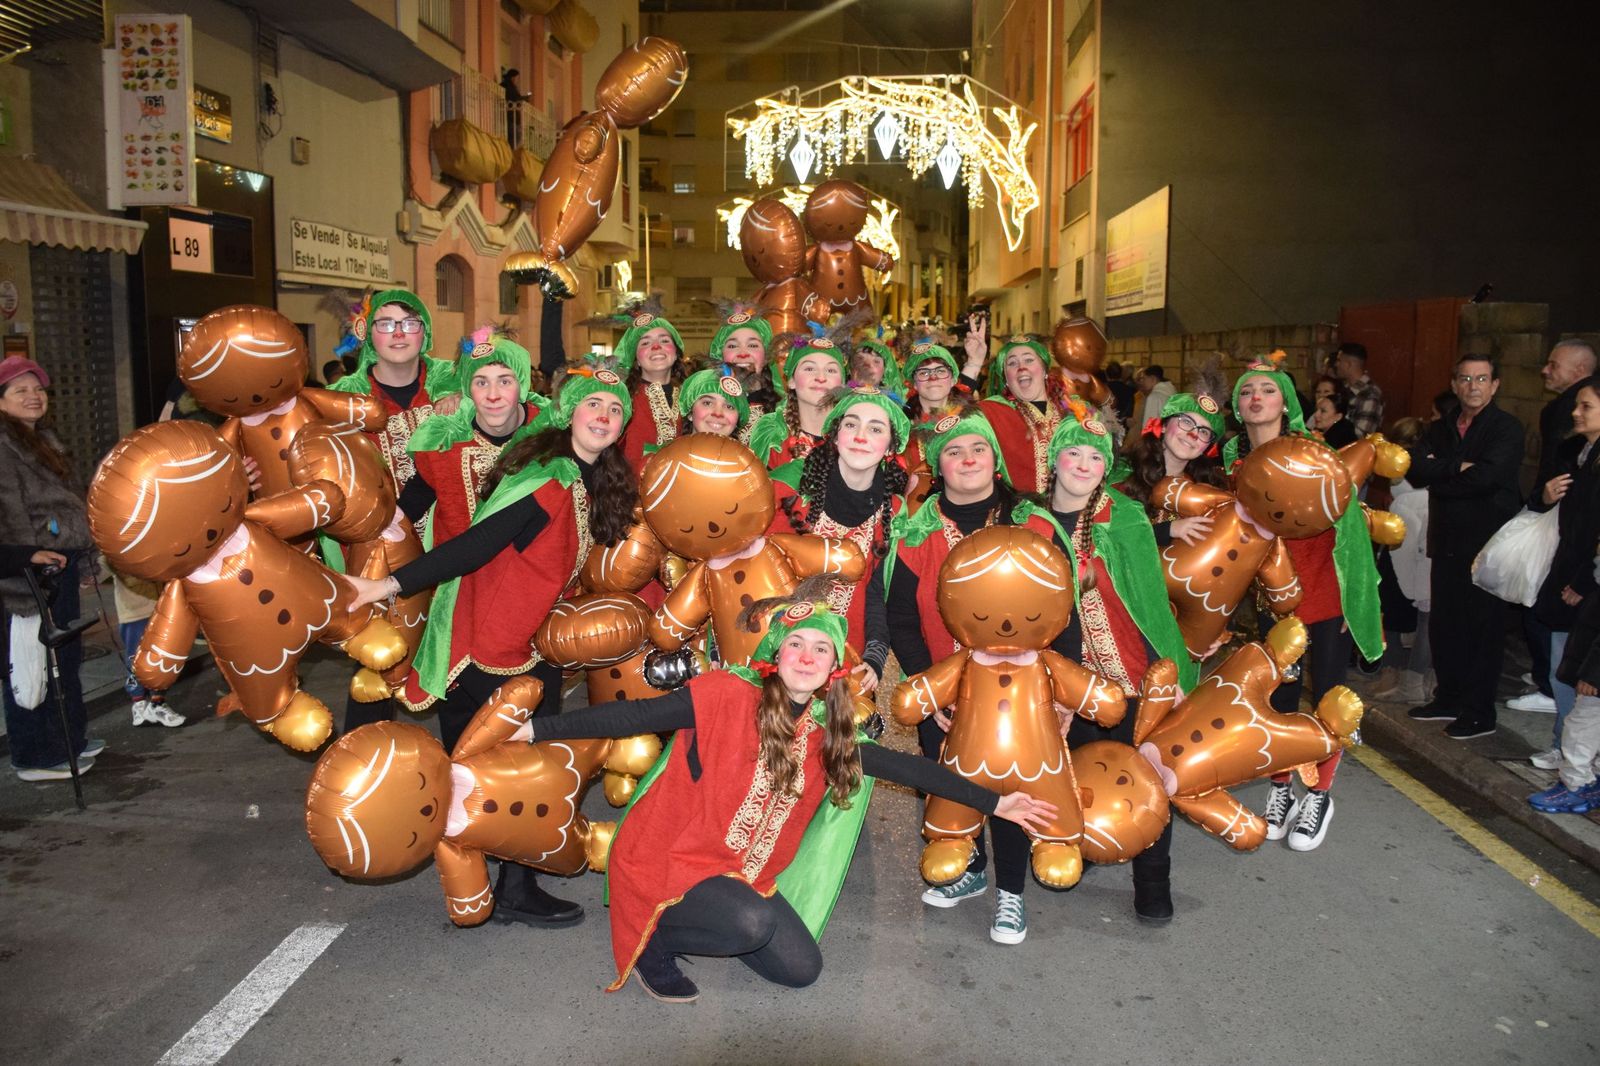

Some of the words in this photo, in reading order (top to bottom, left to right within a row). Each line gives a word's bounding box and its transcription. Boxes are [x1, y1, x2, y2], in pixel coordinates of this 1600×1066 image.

[184, 237, 199, 257] 89
[293, 221, 308, 240] Se
[311, 225, 340, 246] Vende
[346, 232, 359, 249] Se
[361, 237, 388, 257] Alquila
[295, 250, 316, 268] Este
[318, 253, 341, 271] Local
